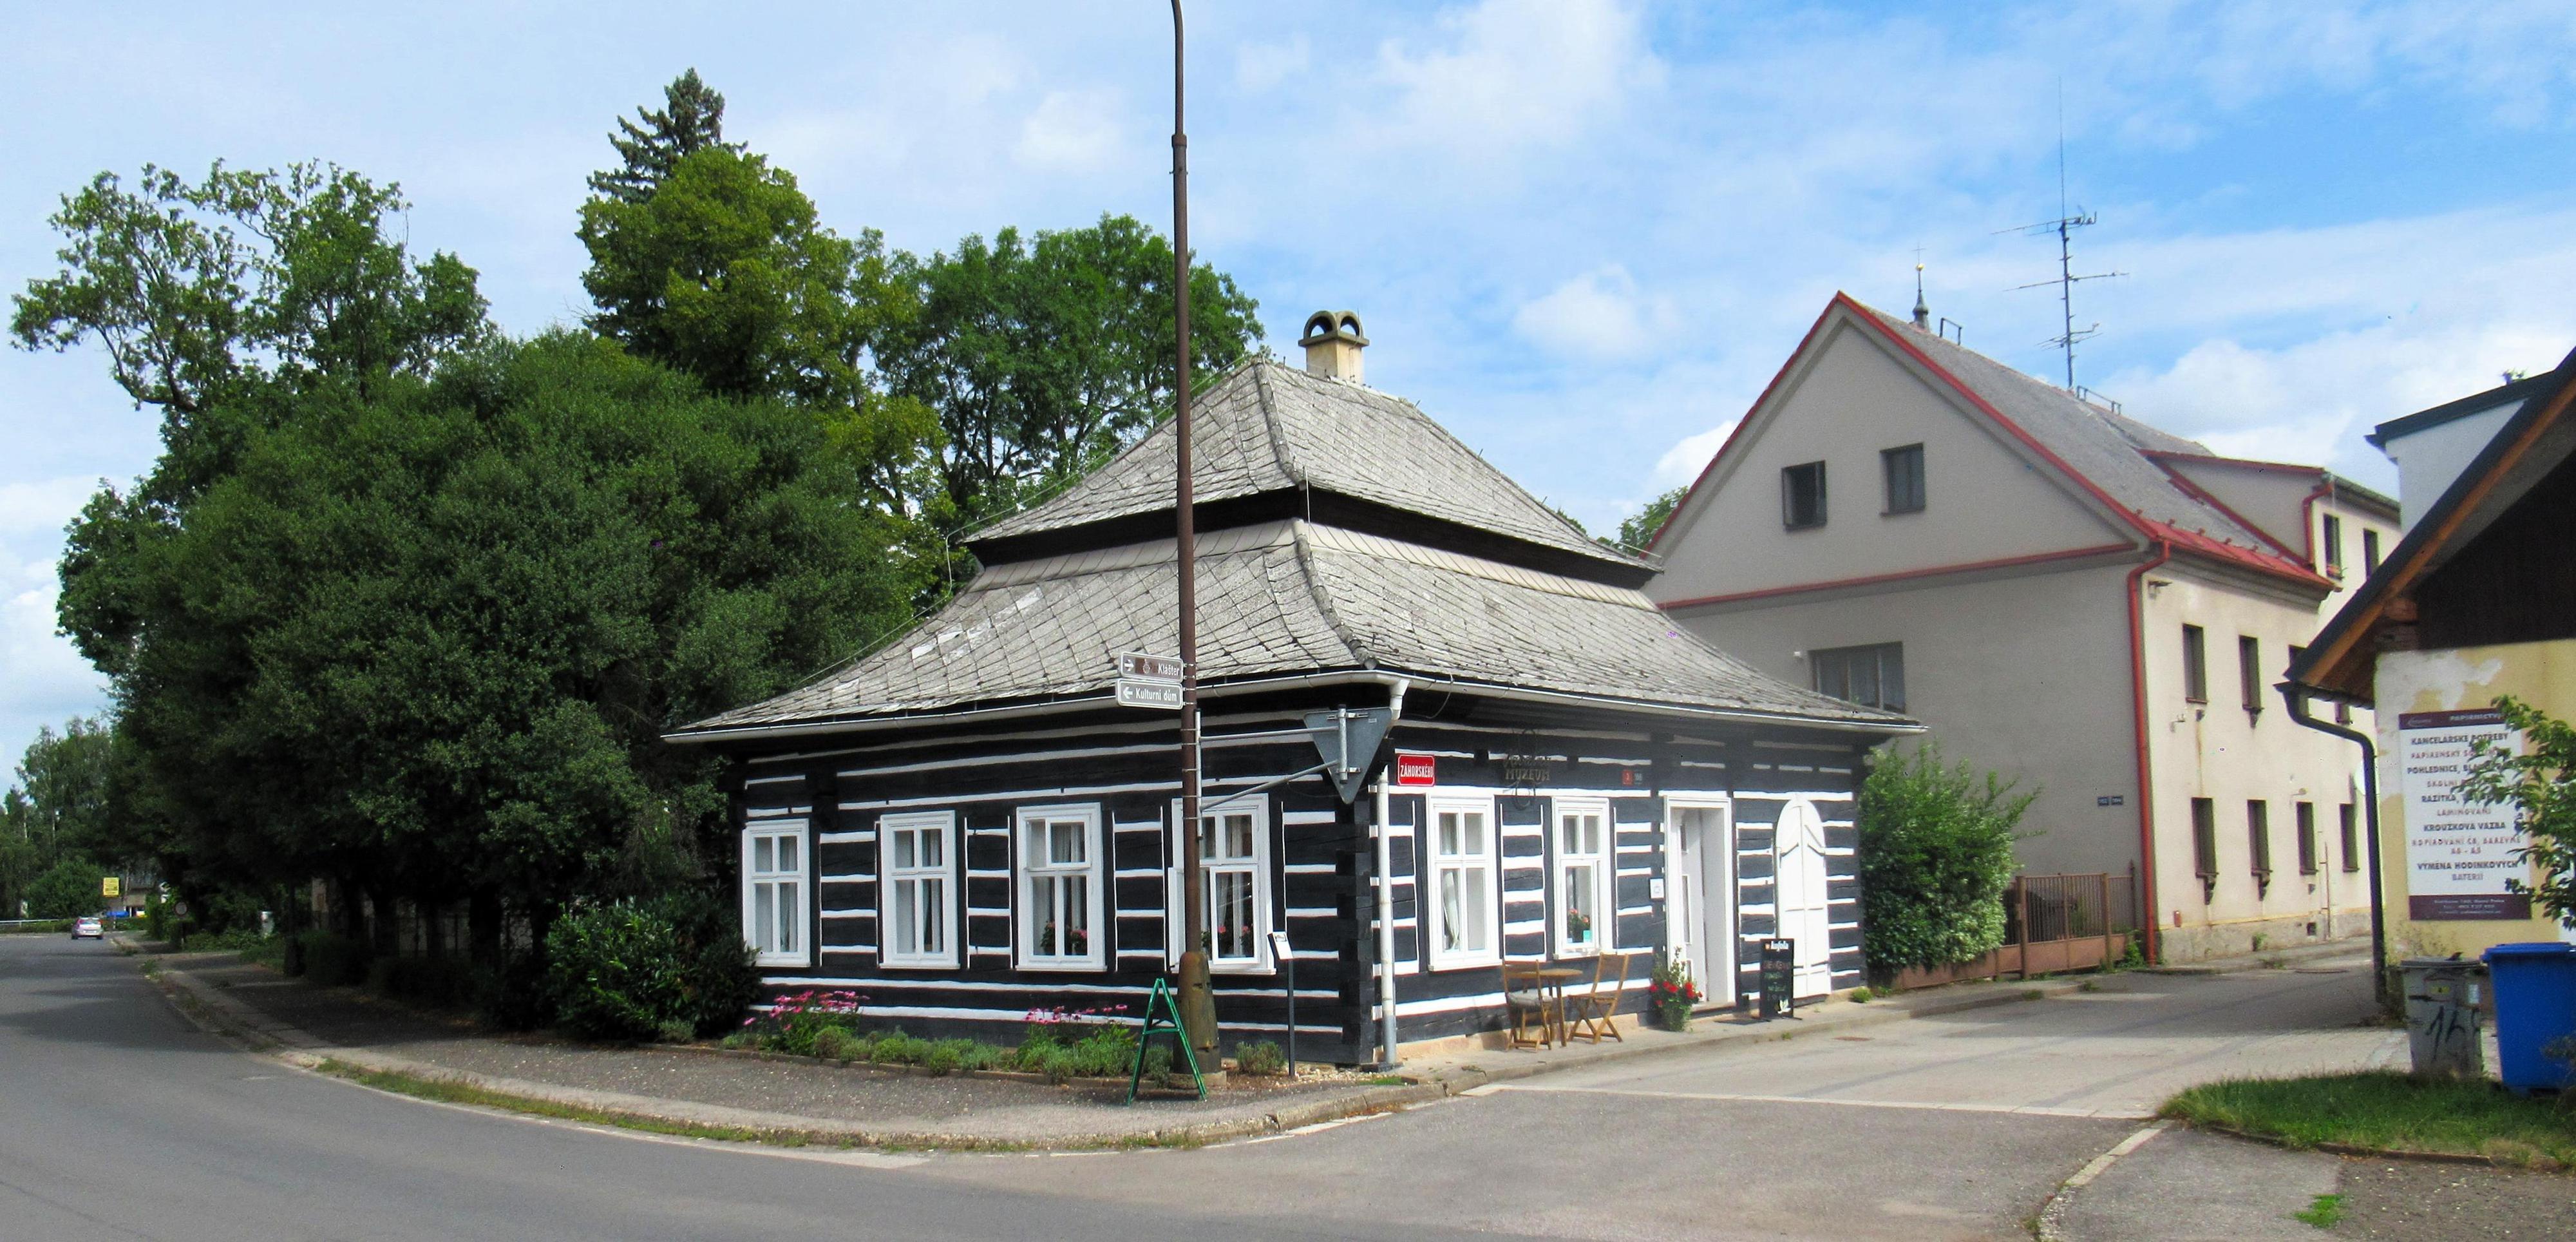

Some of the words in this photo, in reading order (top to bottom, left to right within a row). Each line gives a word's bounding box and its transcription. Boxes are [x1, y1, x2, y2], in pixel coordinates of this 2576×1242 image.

[1159, 664, 1179, 676] Klášter
[1164, 690, 1177, 701] dům
[1400, 763, 1434, 778] ZÁHORSKÉHO
